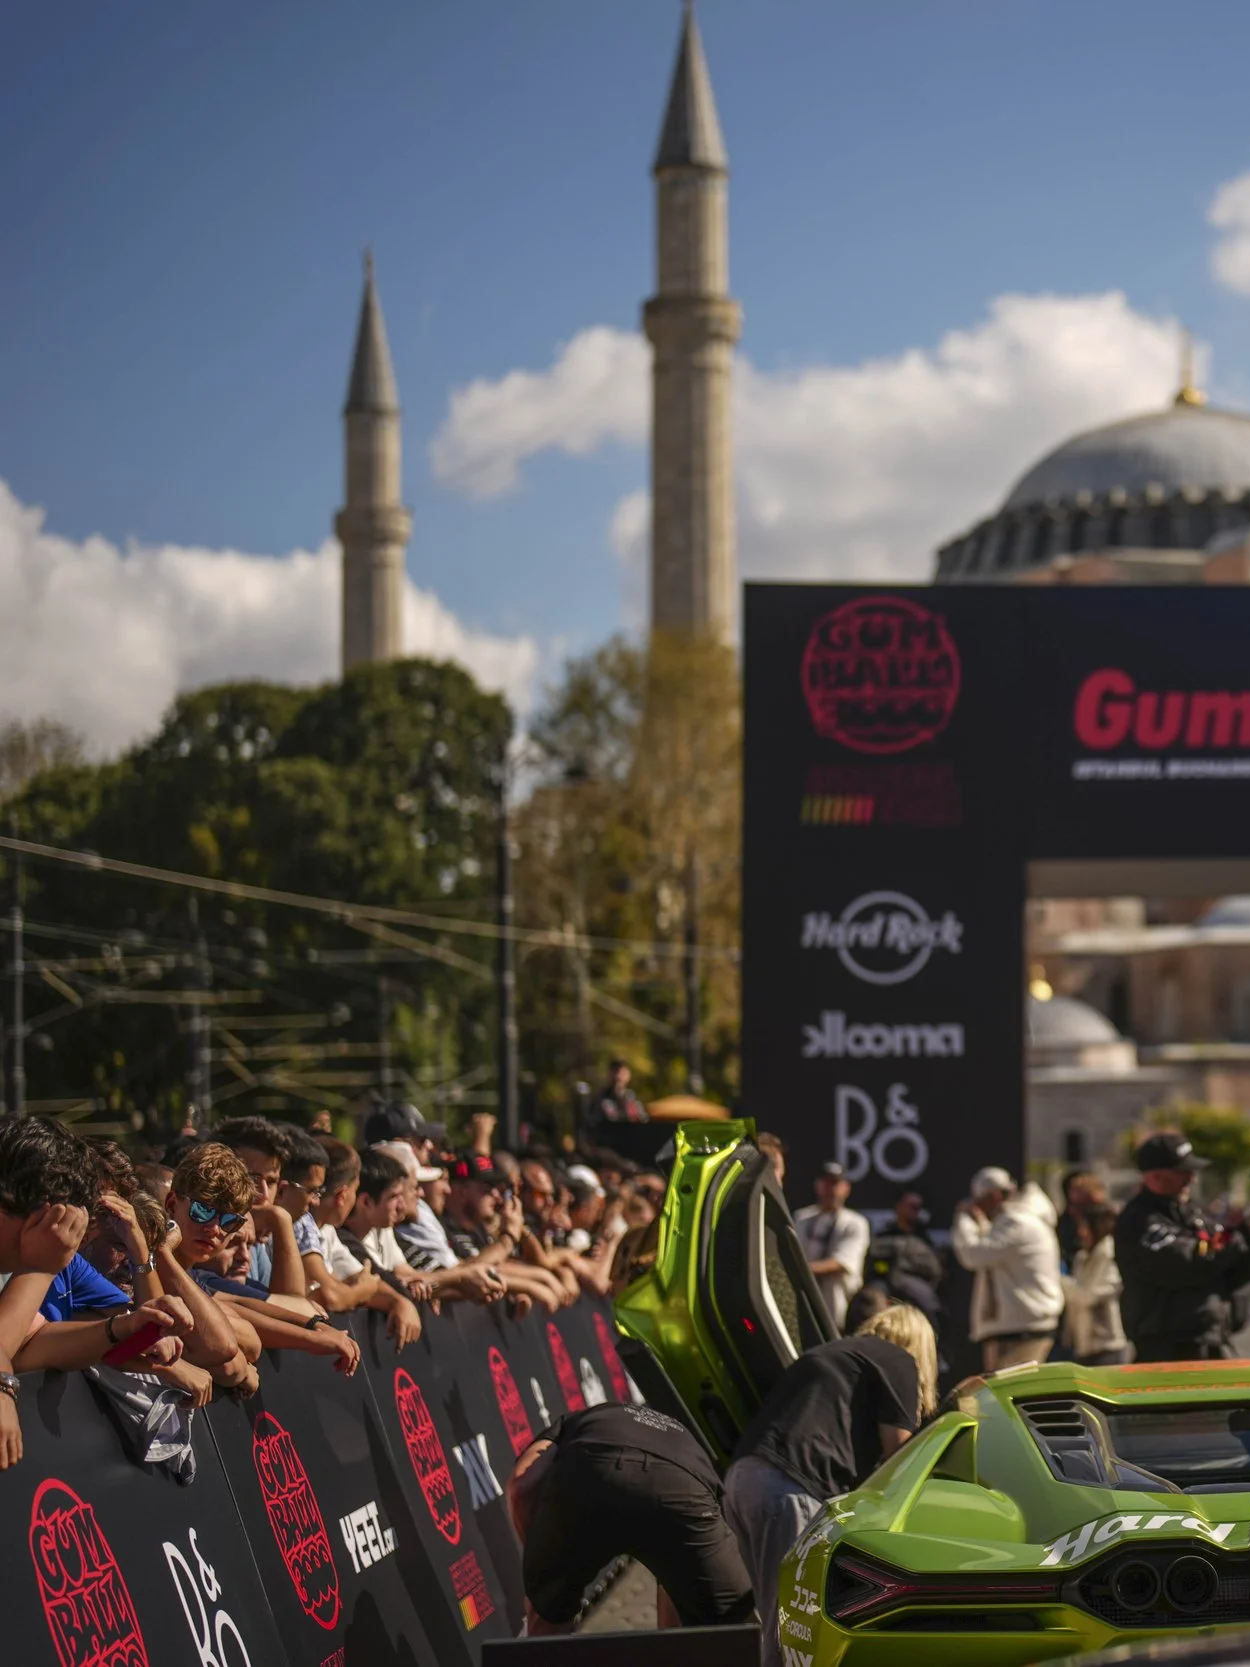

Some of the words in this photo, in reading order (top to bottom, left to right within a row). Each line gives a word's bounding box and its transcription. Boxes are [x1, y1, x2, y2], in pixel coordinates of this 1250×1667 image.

[801, 911, 883, 950] Hard
[885, 911, 963, 955] Rock
[1038, 1511, 1236, 1567] Hard
